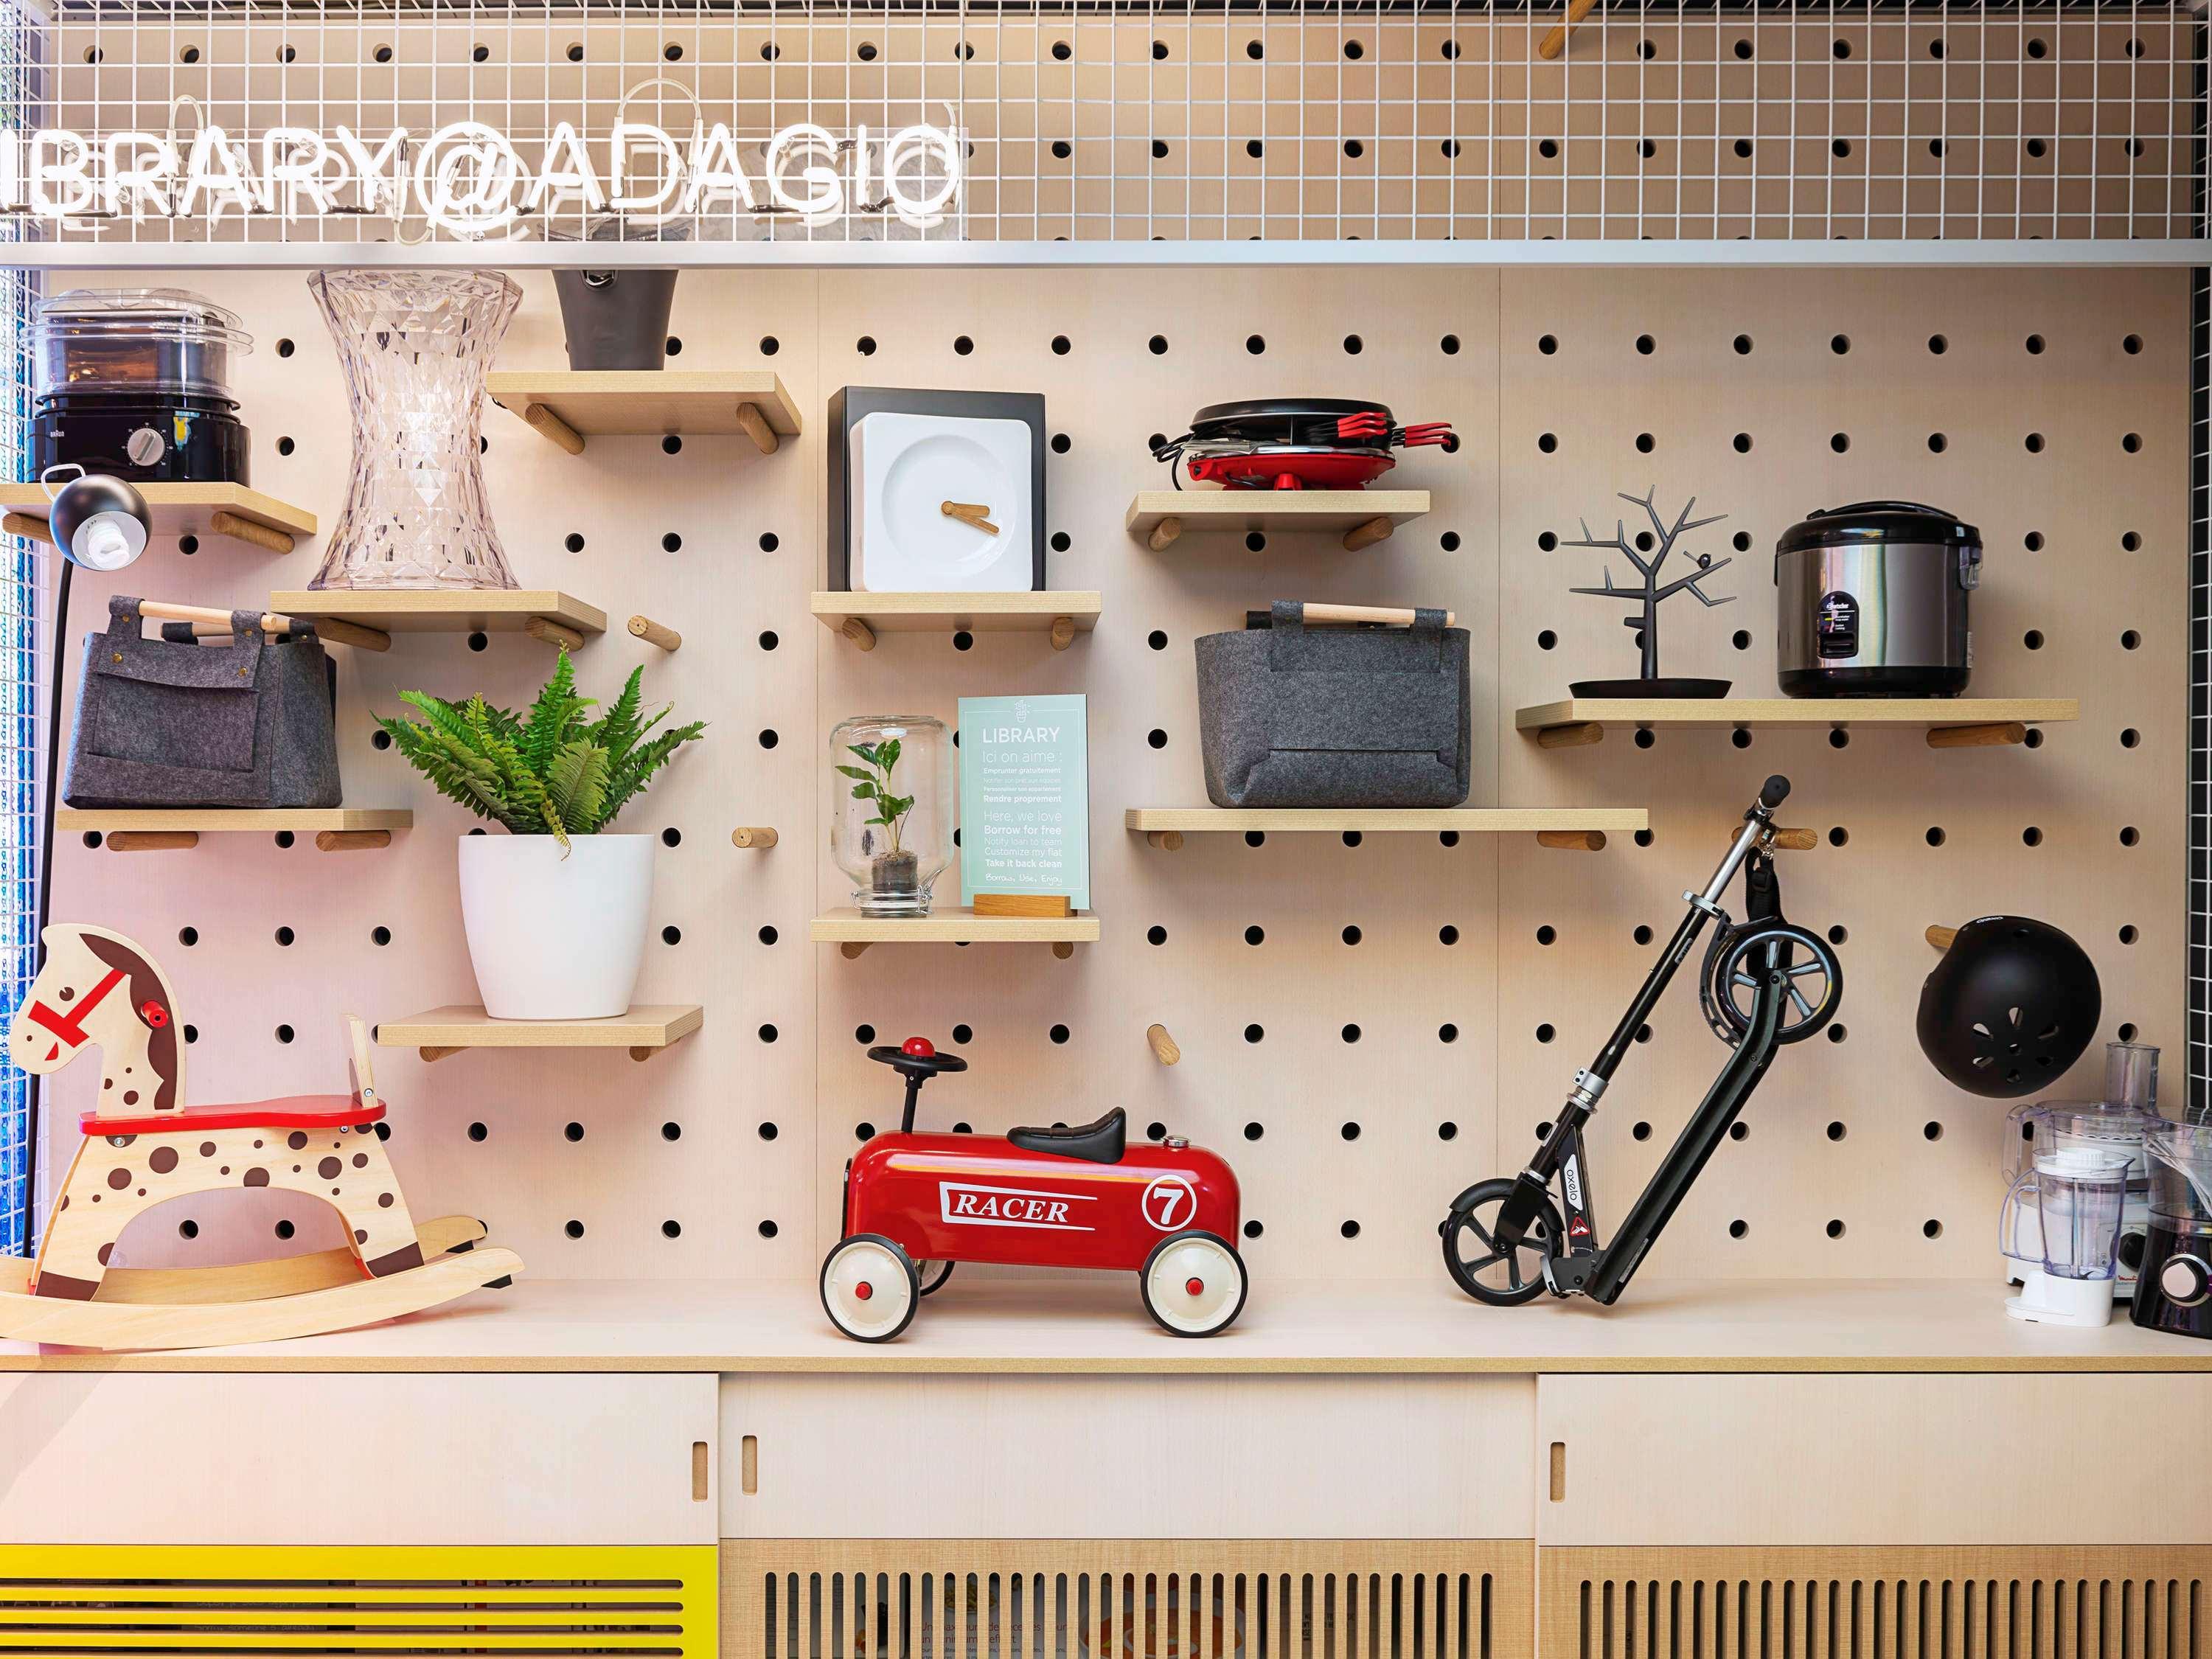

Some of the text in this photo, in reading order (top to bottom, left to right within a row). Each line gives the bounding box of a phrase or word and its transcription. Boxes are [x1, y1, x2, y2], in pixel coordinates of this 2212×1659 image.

[982, 726, 1060, 744] LIBRARY
[982, 750, 997, 763] Ici
[1001, 752, 1018, 763] on
[1022, 749, 1055, 763] aime
[1019, 767, 1062, 776] gratuitement
[983, 794, 1062, 804] Rendre proprement
[984, 810, 1062, 824] Here, we love
[984, 824, 1062, 835] Borrow for free
[984, 846, 1062, 858] Customize my flat
[984, 858, 1062, 868] Take it back clean
[1566, 1169, 1579, 1201] oxelo
[953, 1193, 1069, 1223] RACER
[1152, 1186, 1184, 1225] 7
